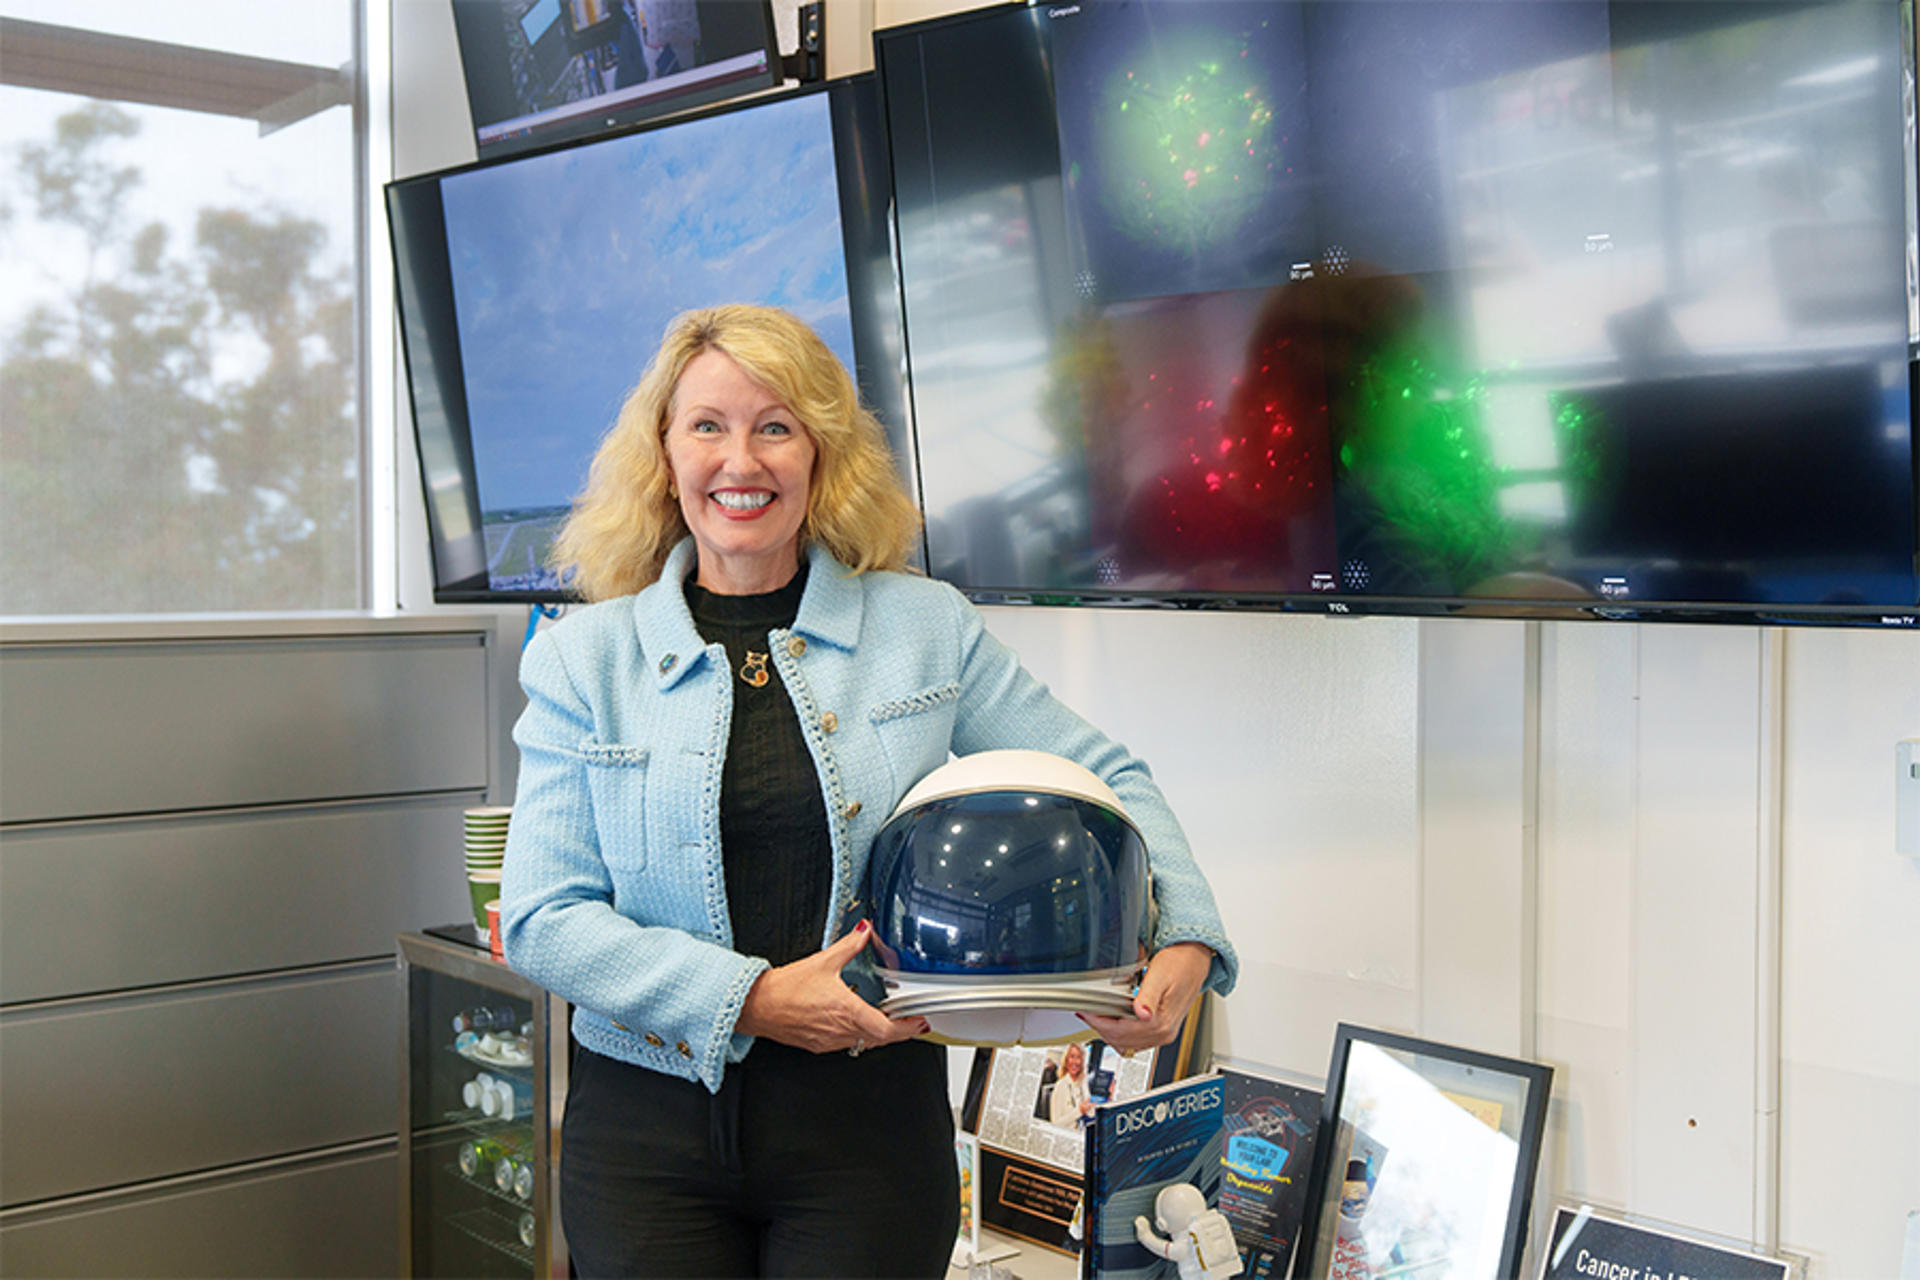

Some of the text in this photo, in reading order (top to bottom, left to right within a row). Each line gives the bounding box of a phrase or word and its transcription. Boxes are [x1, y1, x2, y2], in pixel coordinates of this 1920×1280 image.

[1328, 603, 1349, 613] TCL
[1115, 1087, 1221, 1136] DISCOVERIES
[1575, 1248, 1640, 1280] Cancer
